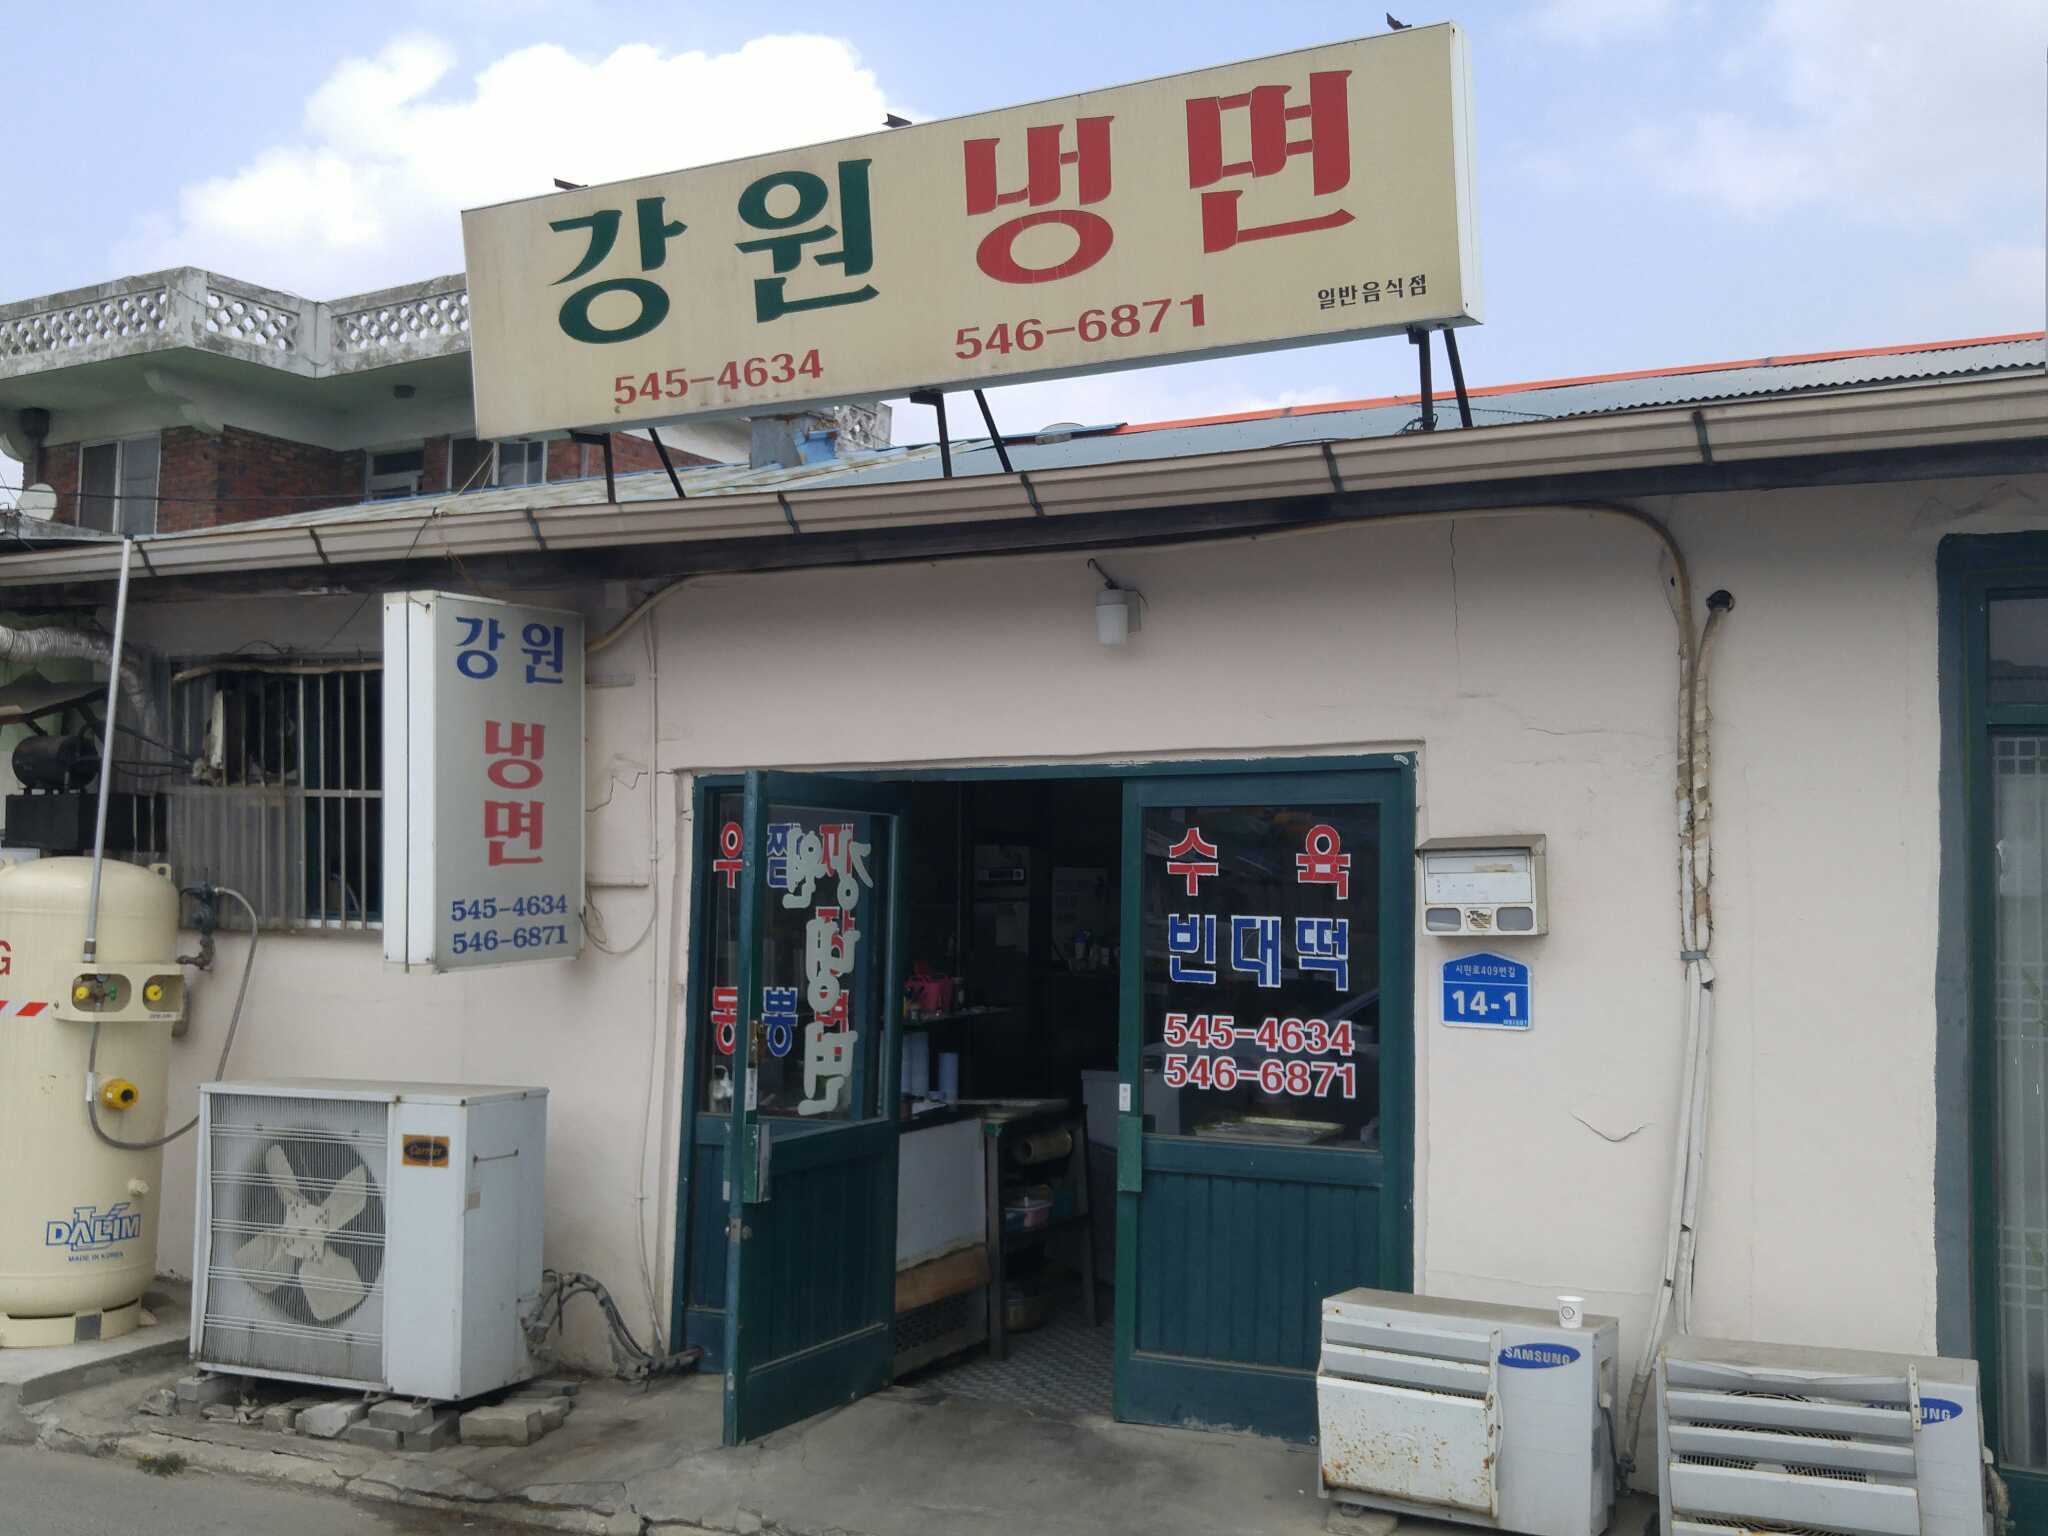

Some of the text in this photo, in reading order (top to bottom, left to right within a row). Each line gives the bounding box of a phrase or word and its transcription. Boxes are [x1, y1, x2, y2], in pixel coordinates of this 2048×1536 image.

[548, 70, 1357, 345] 강원 냉면
[1318, 274, 1428, 310] 일반음식점
[955, 294, 1207, 360] 546-6871
[613, 348, 824, 405] 545-4634
[456, 616, 566, 684] 강원
[484, 719, 547, 868] 냉면
[1167, 824, 1351, 900] 수육
[451, 894, 568, 922] 545-4634
[452, 924, 569, 954] 546-6871
[1168, 913, 1349, 991] 빈대떡
[1451, 990, 1517, 1017] 14-1
[1164, 1013, 1355, 1056] 545-4634
[1164, 1053, 1357, 1099] 546-6871
[1504, 1347, 1571, 1365] SAMSUNG
